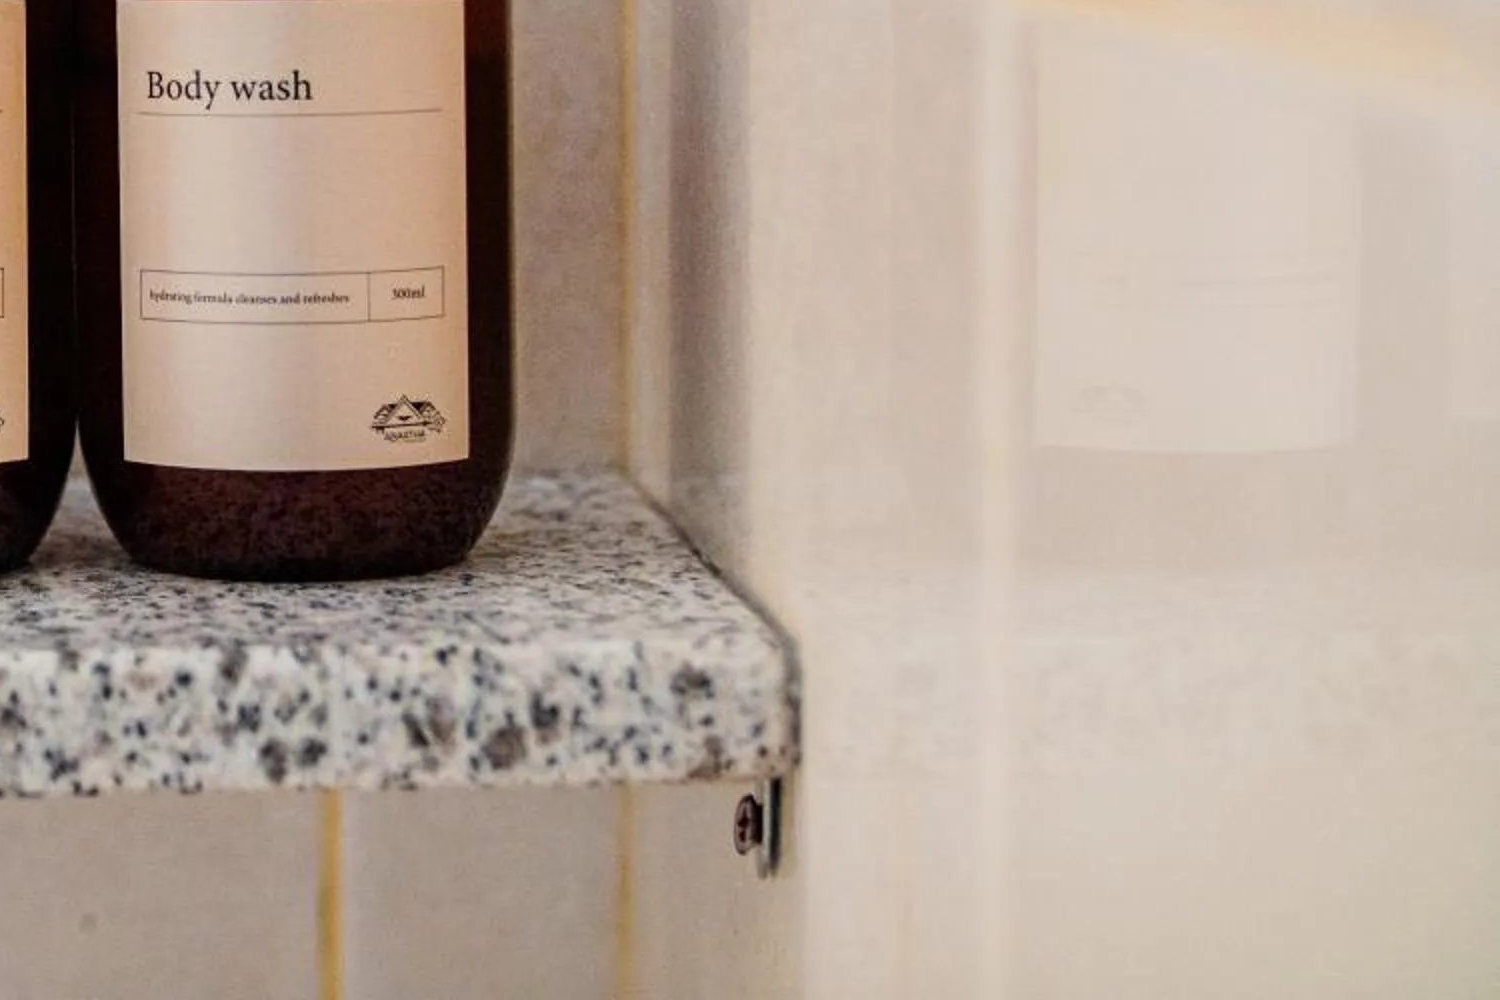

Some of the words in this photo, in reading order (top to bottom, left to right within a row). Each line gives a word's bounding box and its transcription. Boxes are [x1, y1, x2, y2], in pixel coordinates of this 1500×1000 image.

[147, 69, 222, 111] Body
[231, 70, 313, 101] wash
[149, 288, 192, 305] hydrating
[193, 291, 233, 303] formula
[280, 290, 301, 304] and
